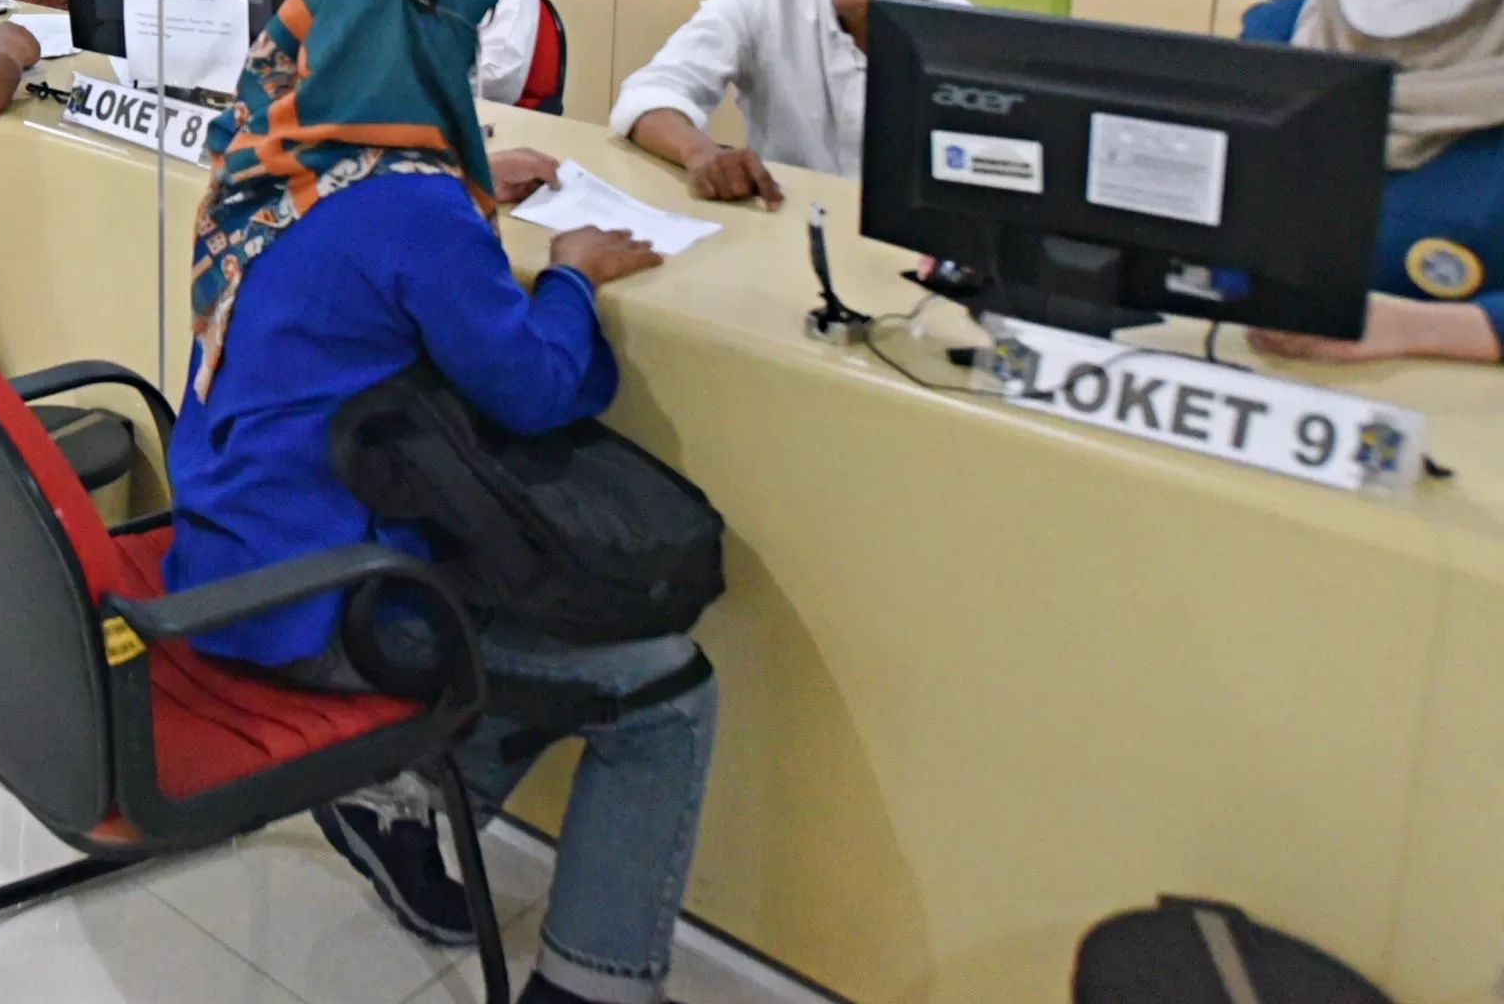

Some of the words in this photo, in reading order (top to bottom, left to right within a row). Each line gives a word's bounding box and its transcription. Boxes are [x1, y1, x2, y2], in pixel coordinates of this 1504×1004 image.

[81, 83, 180, 139] LOKET
[180, 115, 203, 148] 8
[931, 83, 1025, 115] acer
[1019, 351, 1268, 451] LOKET
[1292, 412, 1338, 468] 9
